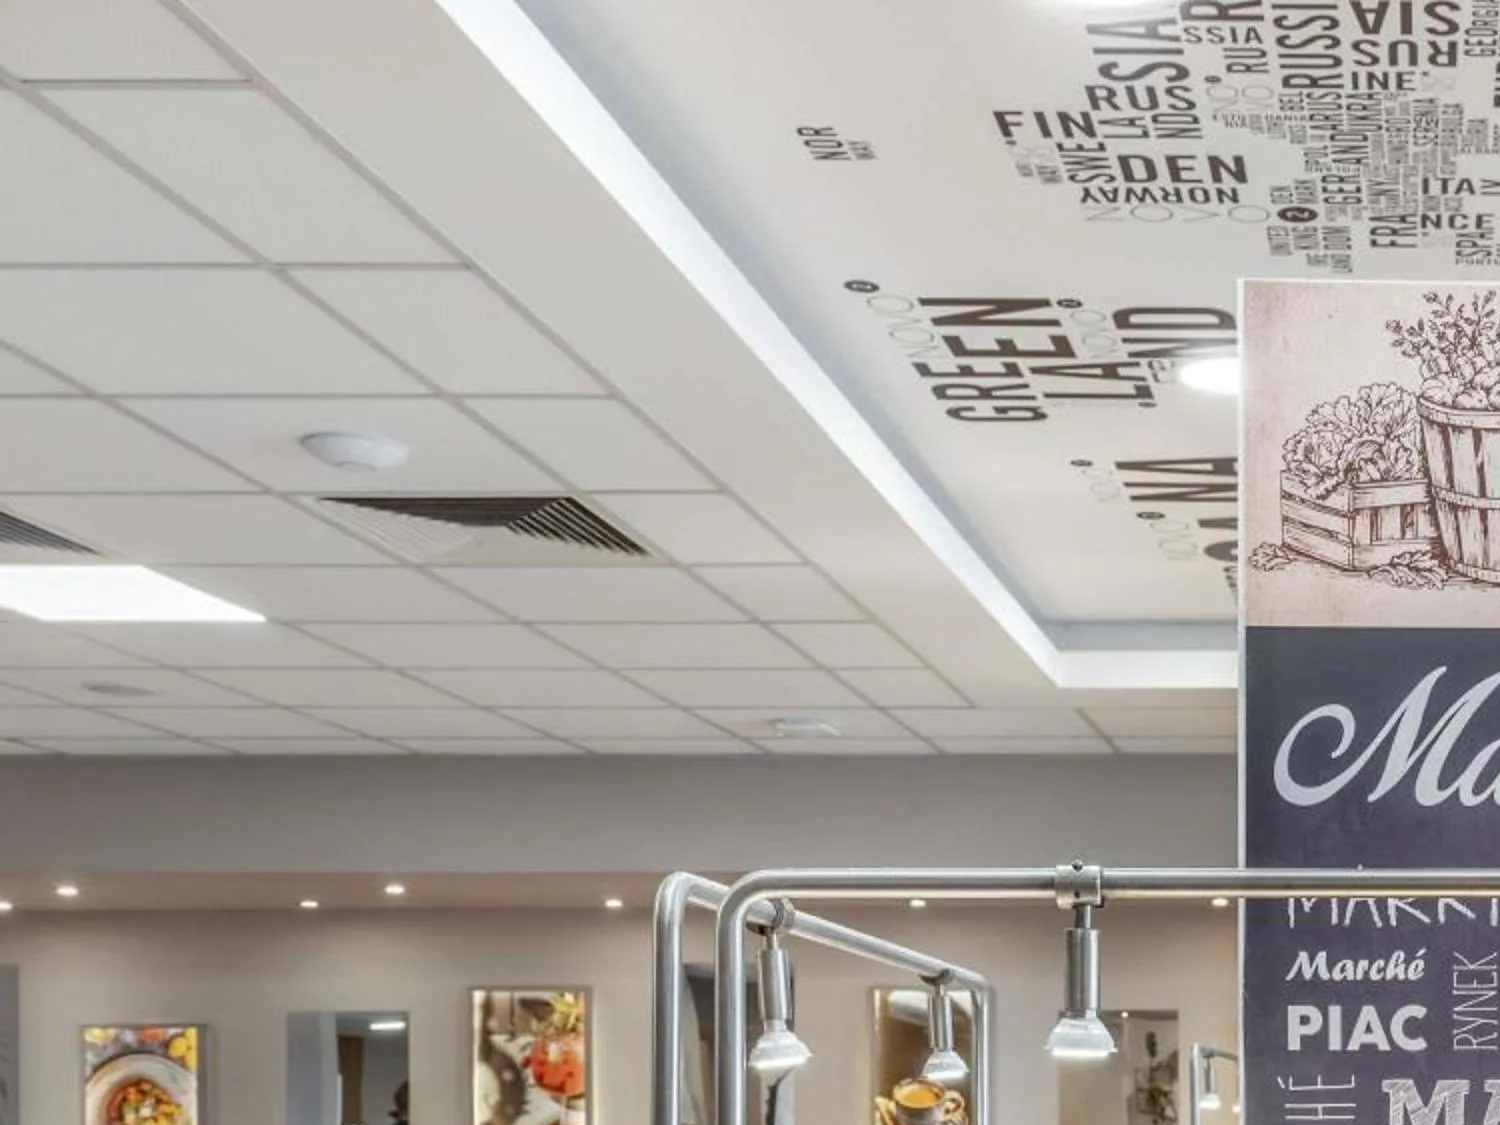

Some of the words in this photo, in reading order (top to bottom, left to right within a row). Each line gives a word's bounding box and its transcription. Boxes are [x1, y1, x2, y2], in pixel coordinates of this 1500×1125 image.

[992, 110, 1098, 139] FIN
[1117, 154, 1249, 184] DEN
[1285, 947, 1428, 982] Marché
[1452, 950, 1499, 1051] RYNEK
[1287, 1004, 1429, 1051] PIAC
